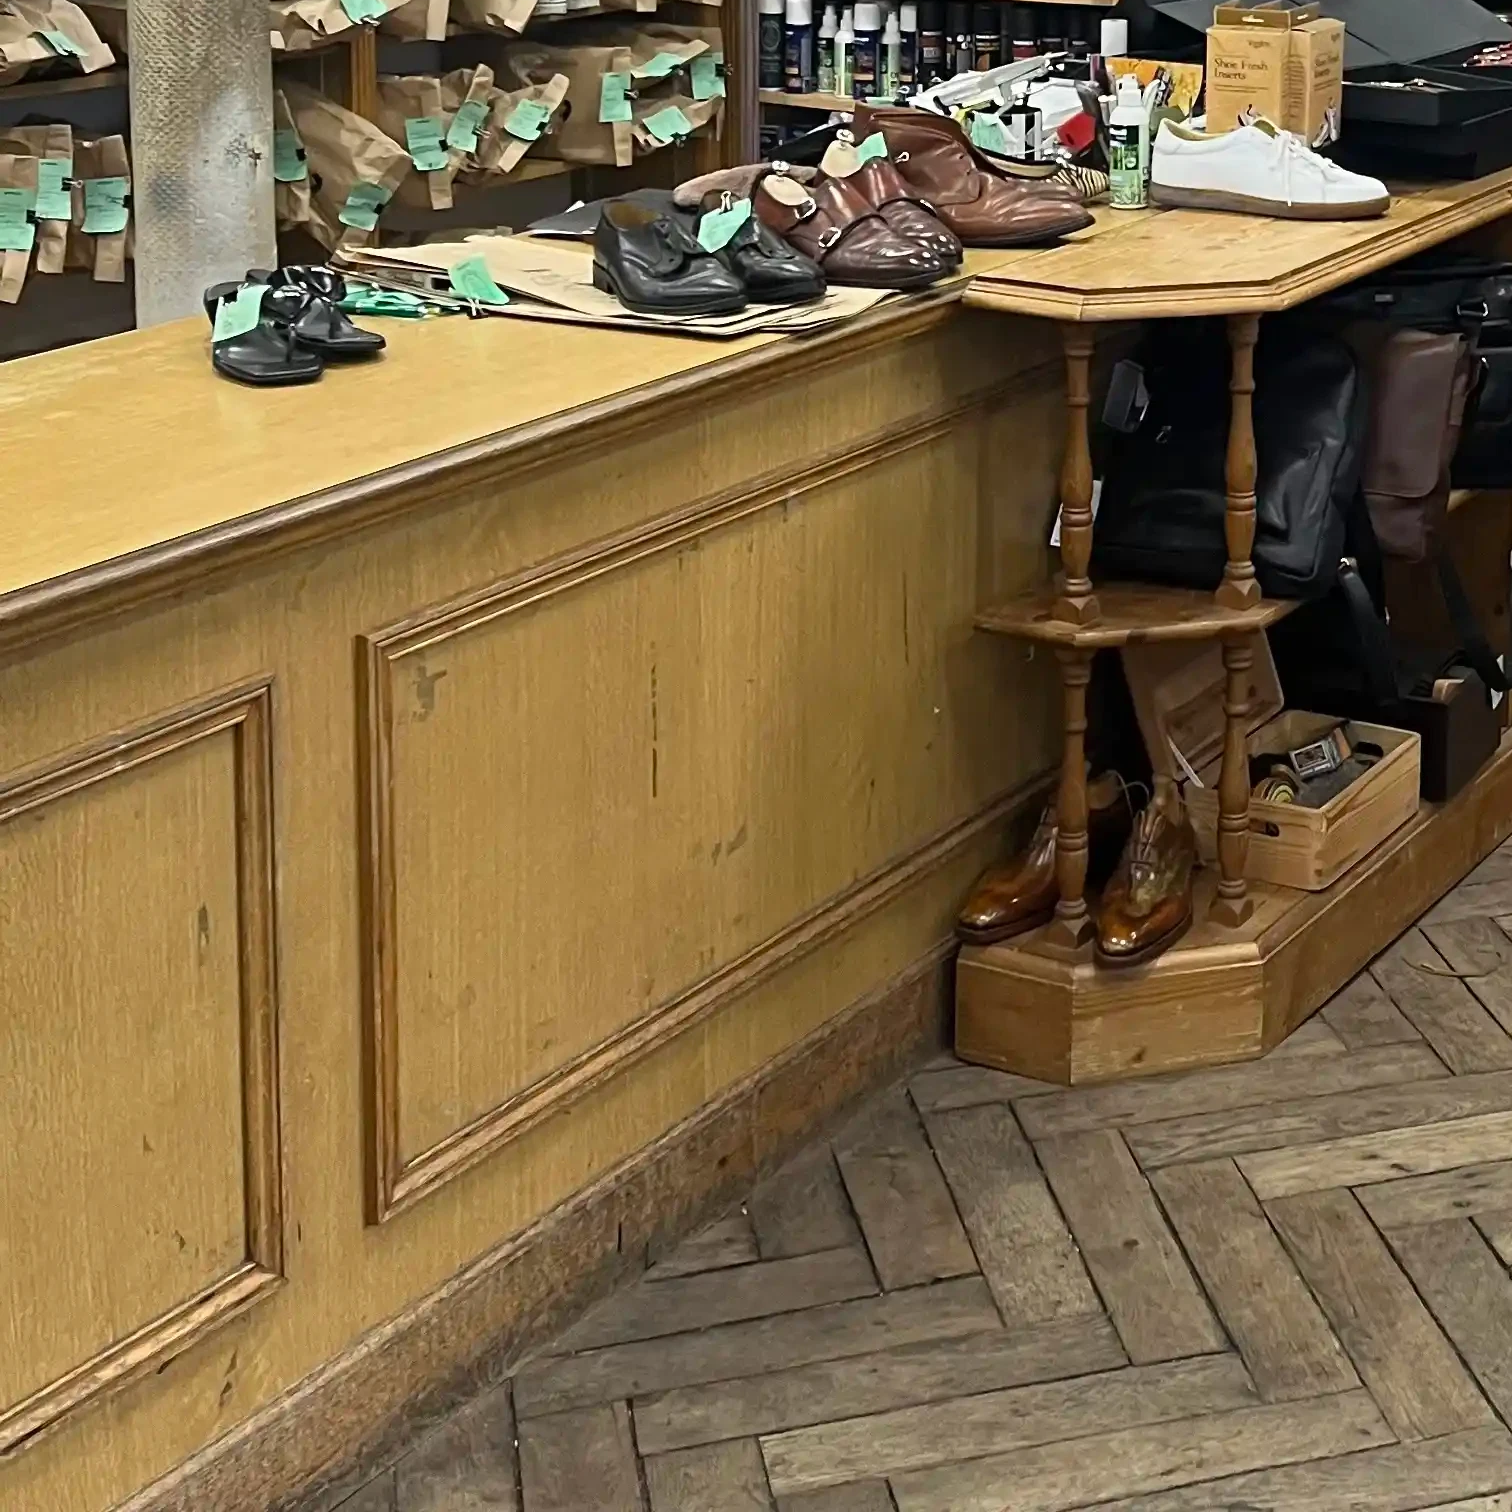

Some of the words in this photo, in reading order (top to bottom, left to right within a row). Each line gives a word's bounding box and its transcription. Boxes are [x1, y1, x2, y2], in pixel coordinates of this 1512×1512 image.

[1214, 57, 1238, 70] Shoe
[1241, 59, 1269, 71] Fresh
[1214, 68, 1247, 81] Inserts
